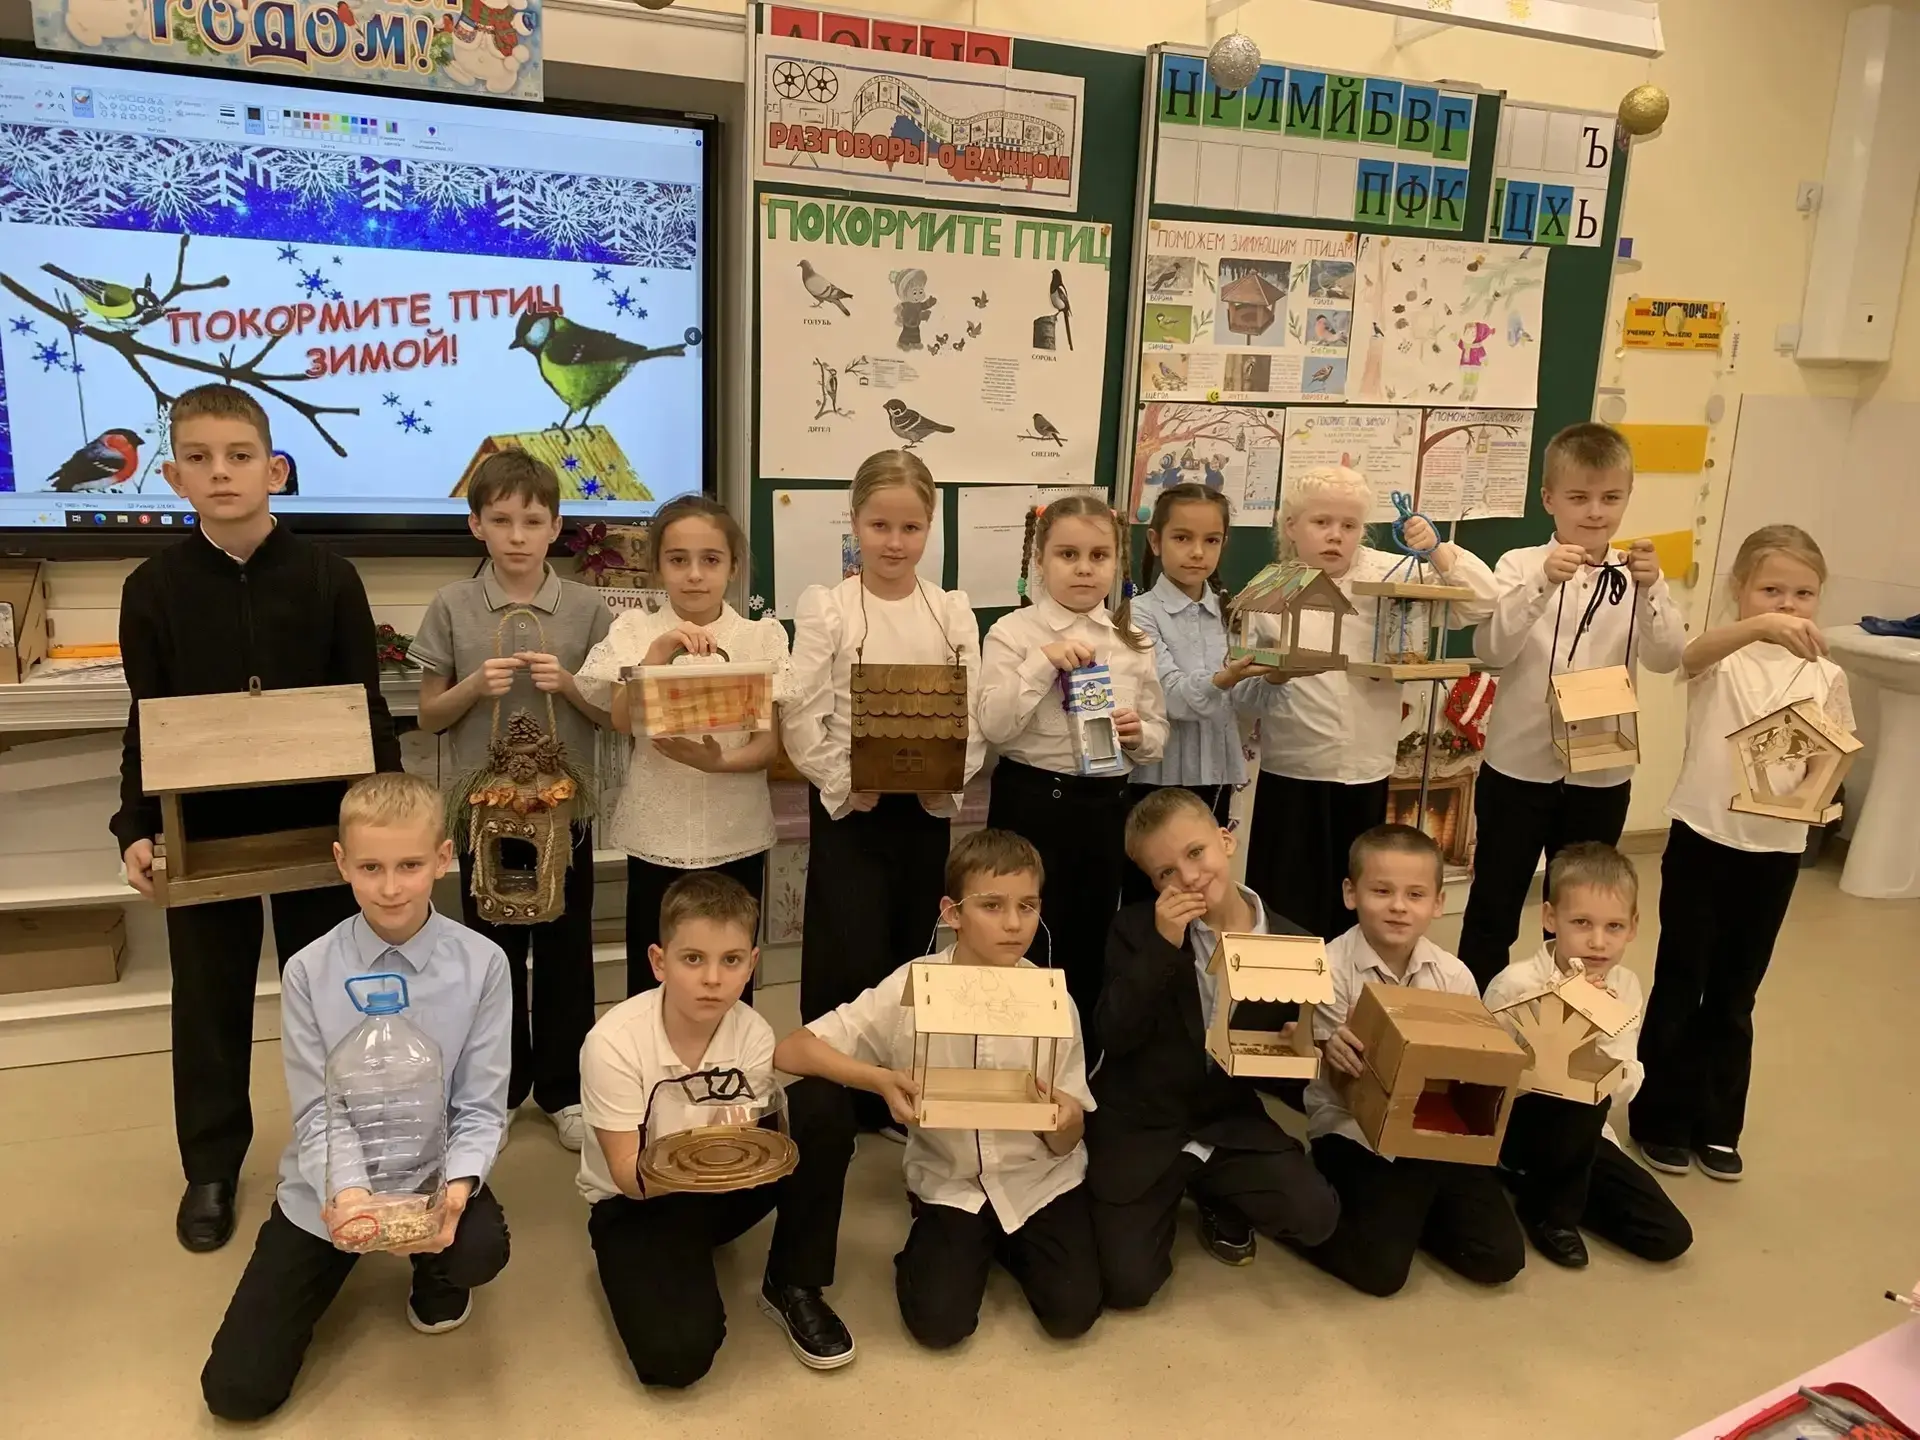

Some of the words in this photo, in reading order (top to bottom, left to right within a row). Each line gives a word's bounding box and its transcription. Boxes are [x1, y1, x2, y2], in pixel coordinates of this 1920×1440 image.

[1165, 68, 1200, 118] Н
[1247, 77, 1283, 123] Л
[1286, 82, 1325, 130] М
[1327, 77, 1360, 135] Й
[1367, 90, 1394, 136] Б
[1440, 108, 1466, 152] Г
[768, 122, 929, 167] РАЗГОВОРЫ
[937, 142, 957, 170] О
[964, 145, 1071, 181] ВАЖНОМ
[1582, 126, 1609, 169] Ъ
[1358, 171, 1390, 216] П
[1396, 175, 1429, 219] Ф
[1506, 191, 1536, 240] Ц
[1575, 198, 1598, 239] Ь
[767, 198, 1002, 257] ПОКОРМИТЕ
[1013, 219, 1112, 272] ПТИЦ
[1156, 229, 1226, 251] ПОМОЖЕМ
[1230, 233, 1298, 257] ЗИМУЮЩИМ
[165, 292, 431, 346] ПОКОРМИТЕ
[448, 283, 565, 322] ПТИЦ
[802, 318, 832, 326] ГОЛУБЬ
[1626, 329, 1656, 337] УЧЕНИКУ
[1651, 300, 1709, 320] EDURONG
[305, 328, 459, 379] ЗИМОЙ!
[1031, 353, 1057, 362] СОРОКА
